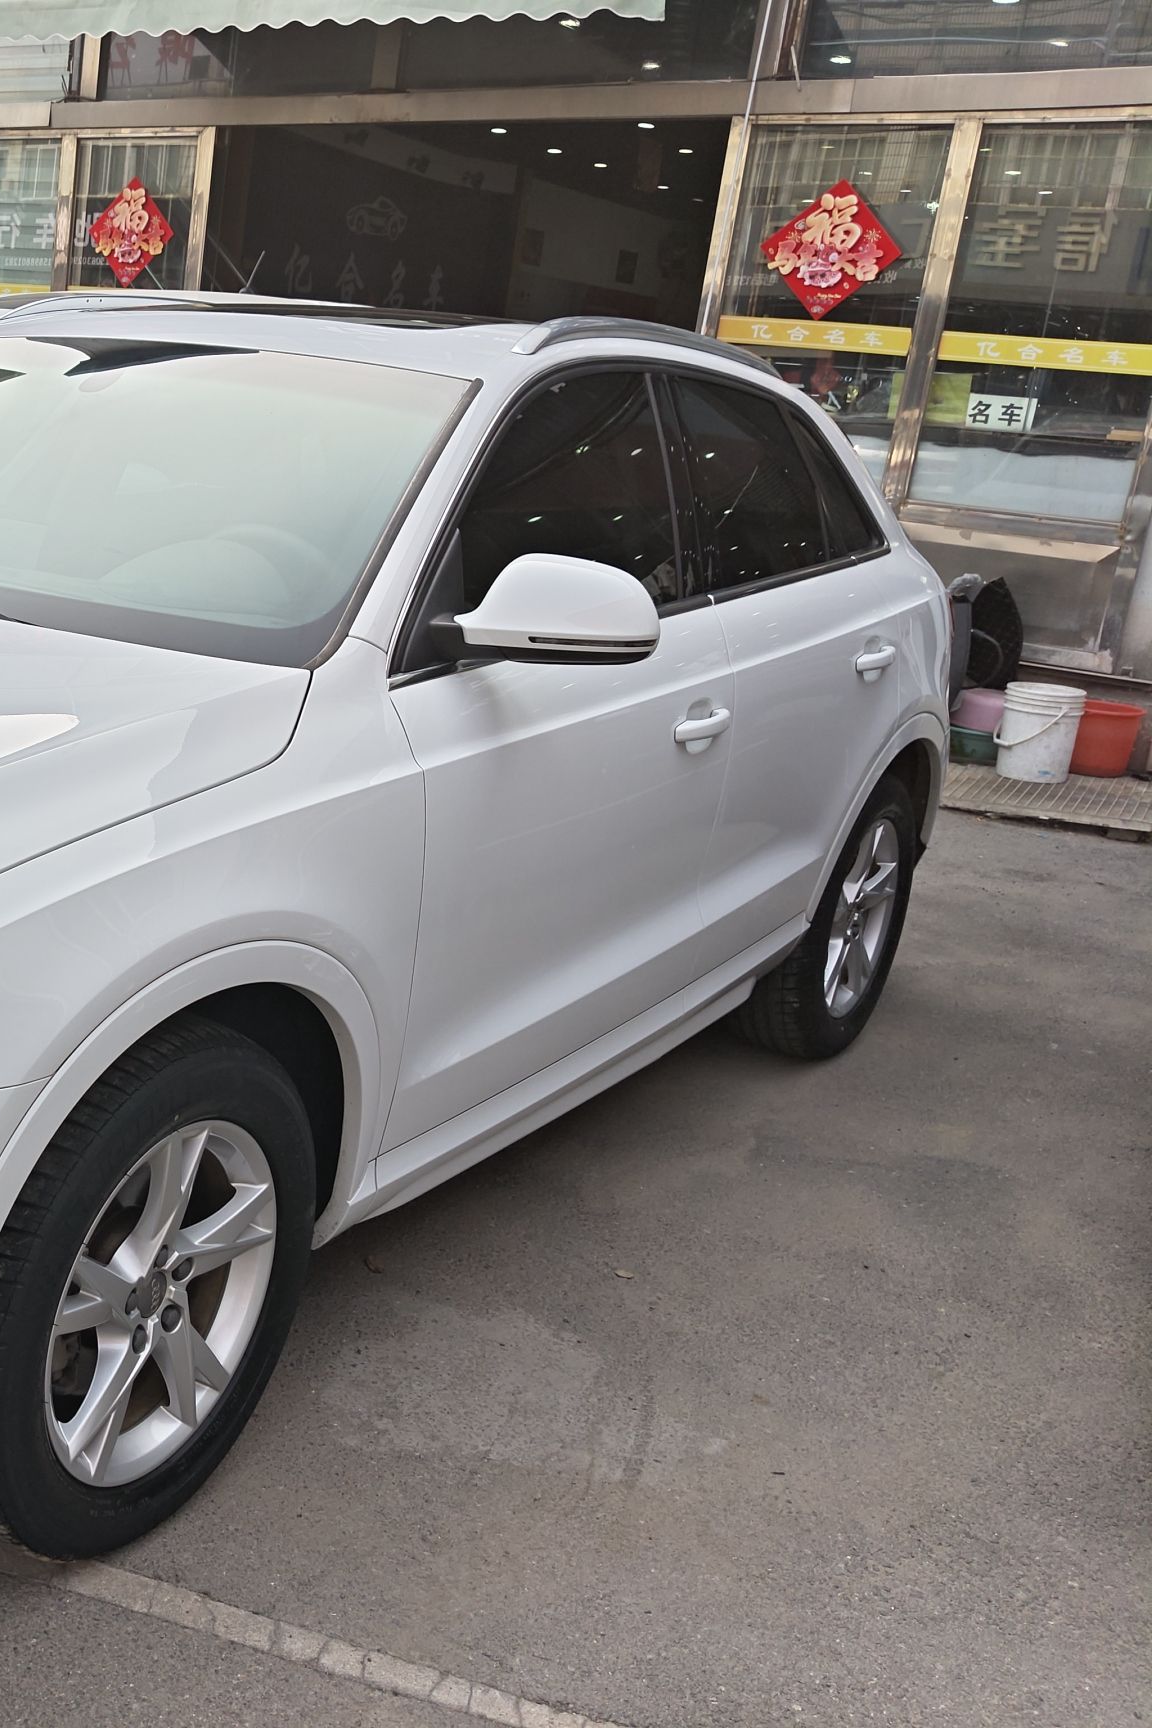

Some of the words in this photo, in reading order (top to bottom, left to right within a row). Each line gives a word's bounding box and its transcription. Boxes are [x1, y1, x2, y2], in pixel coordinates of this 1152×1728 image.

[113, 188, 149, 233] 福
[801, 193, 863, 250] 福
[751, 323, 883, 347] 亿合名车
[977, 340, 1129, 367] 亿合名车
[968, 400, 1024, 427] 名车
